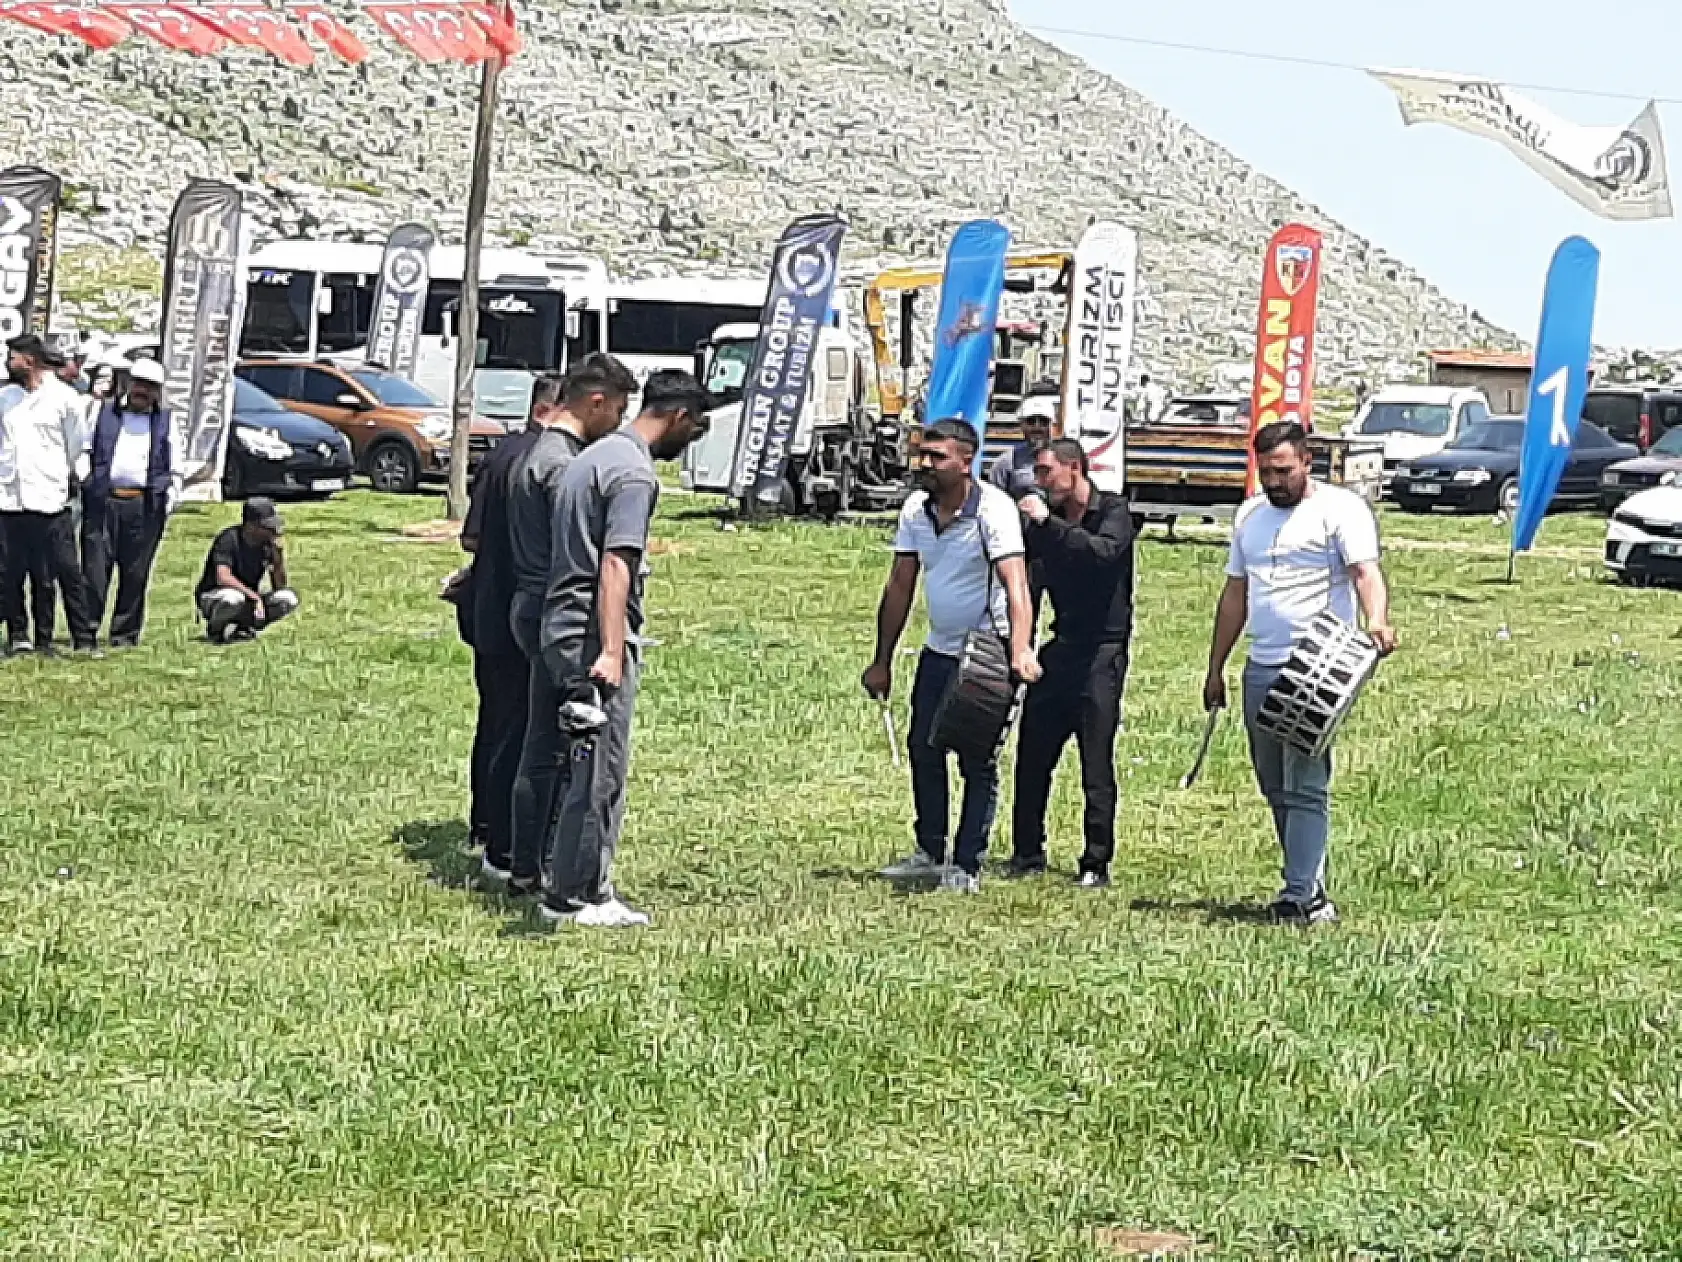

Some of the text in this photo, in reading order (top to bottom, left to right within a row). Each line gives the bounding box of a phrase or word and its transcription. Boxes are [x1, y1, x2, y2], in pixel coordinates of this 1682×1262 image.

[760, 297, 796, 388] GROUP
[1283, 336, 1306, 403] BOYA
[1103, 344, 1123, 411] NUH
